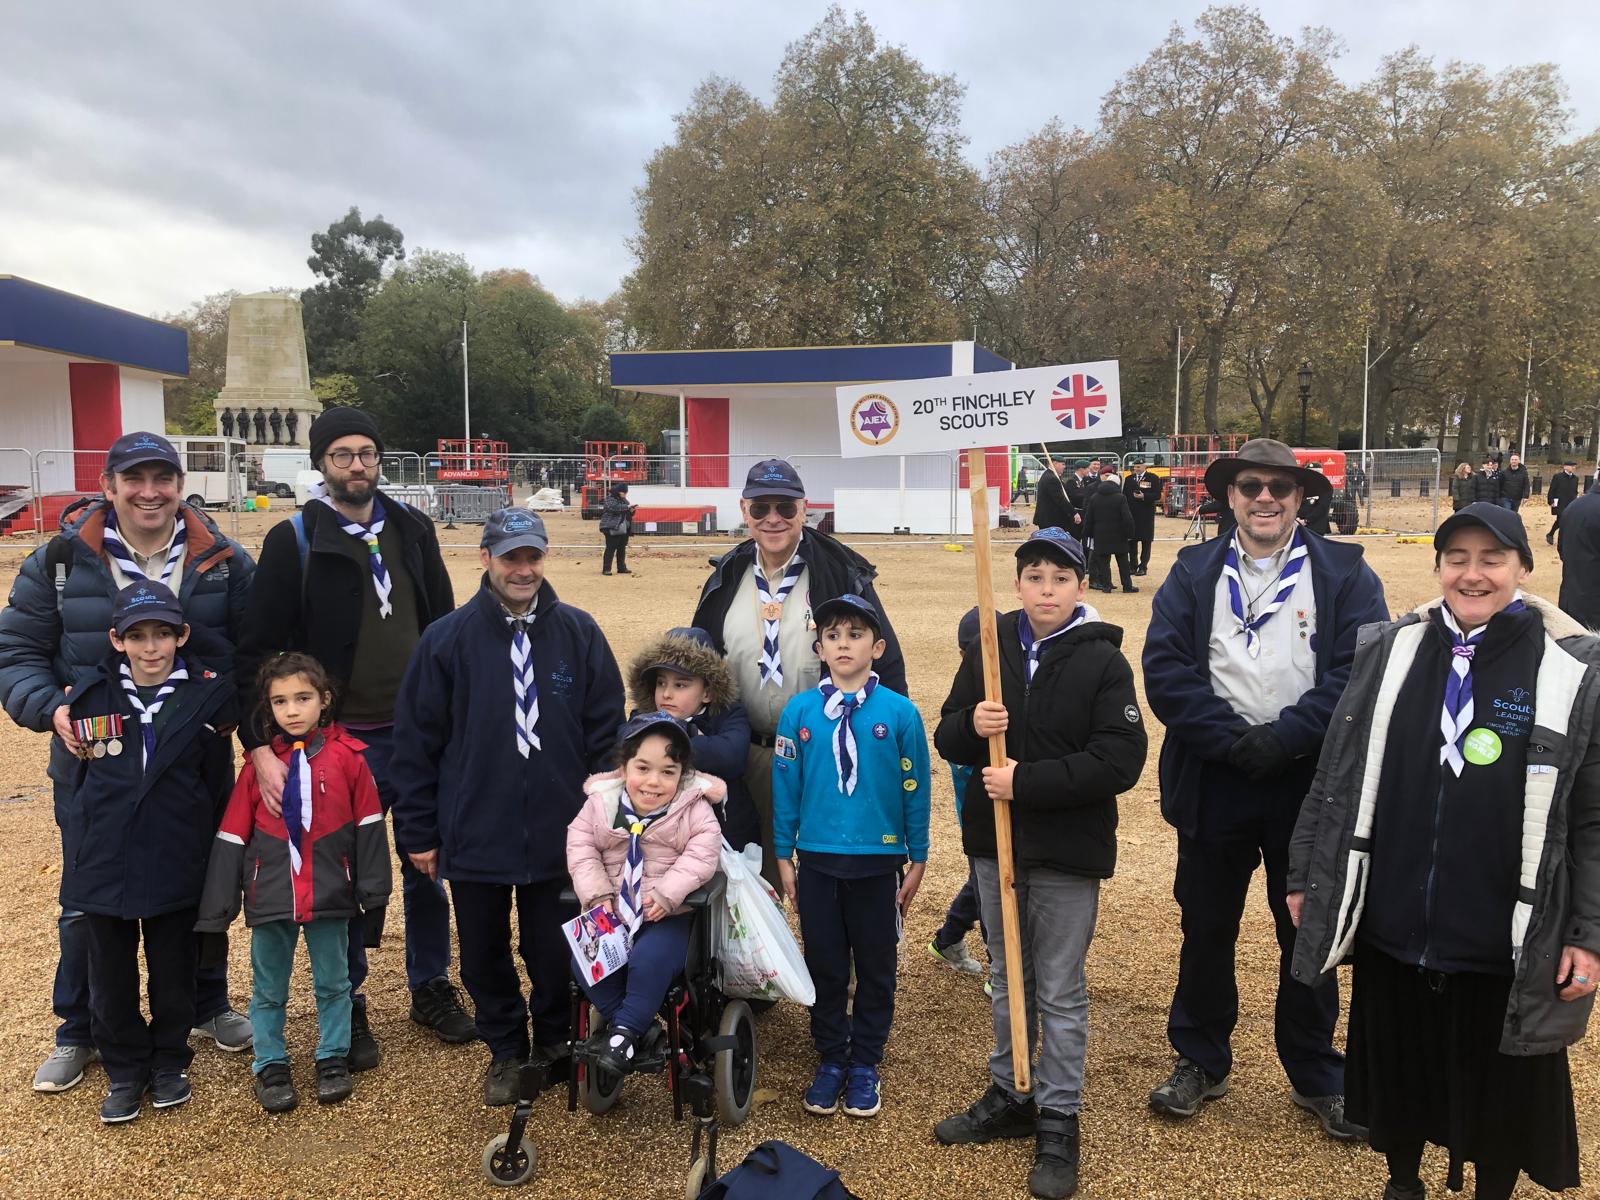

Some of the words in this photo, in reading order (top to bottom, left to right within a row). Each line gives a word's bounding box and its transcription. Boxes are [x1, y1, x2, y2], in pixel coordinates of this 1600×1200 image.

[912, 397, 947, 415] 20TH
[952, 389, 1035, 411] FINCHLEY
[864, 415, 887, 425] AJEX
[940, 411, 1009, 431] SCOUTS
[1495, 711, 1530, 722] LEADER
